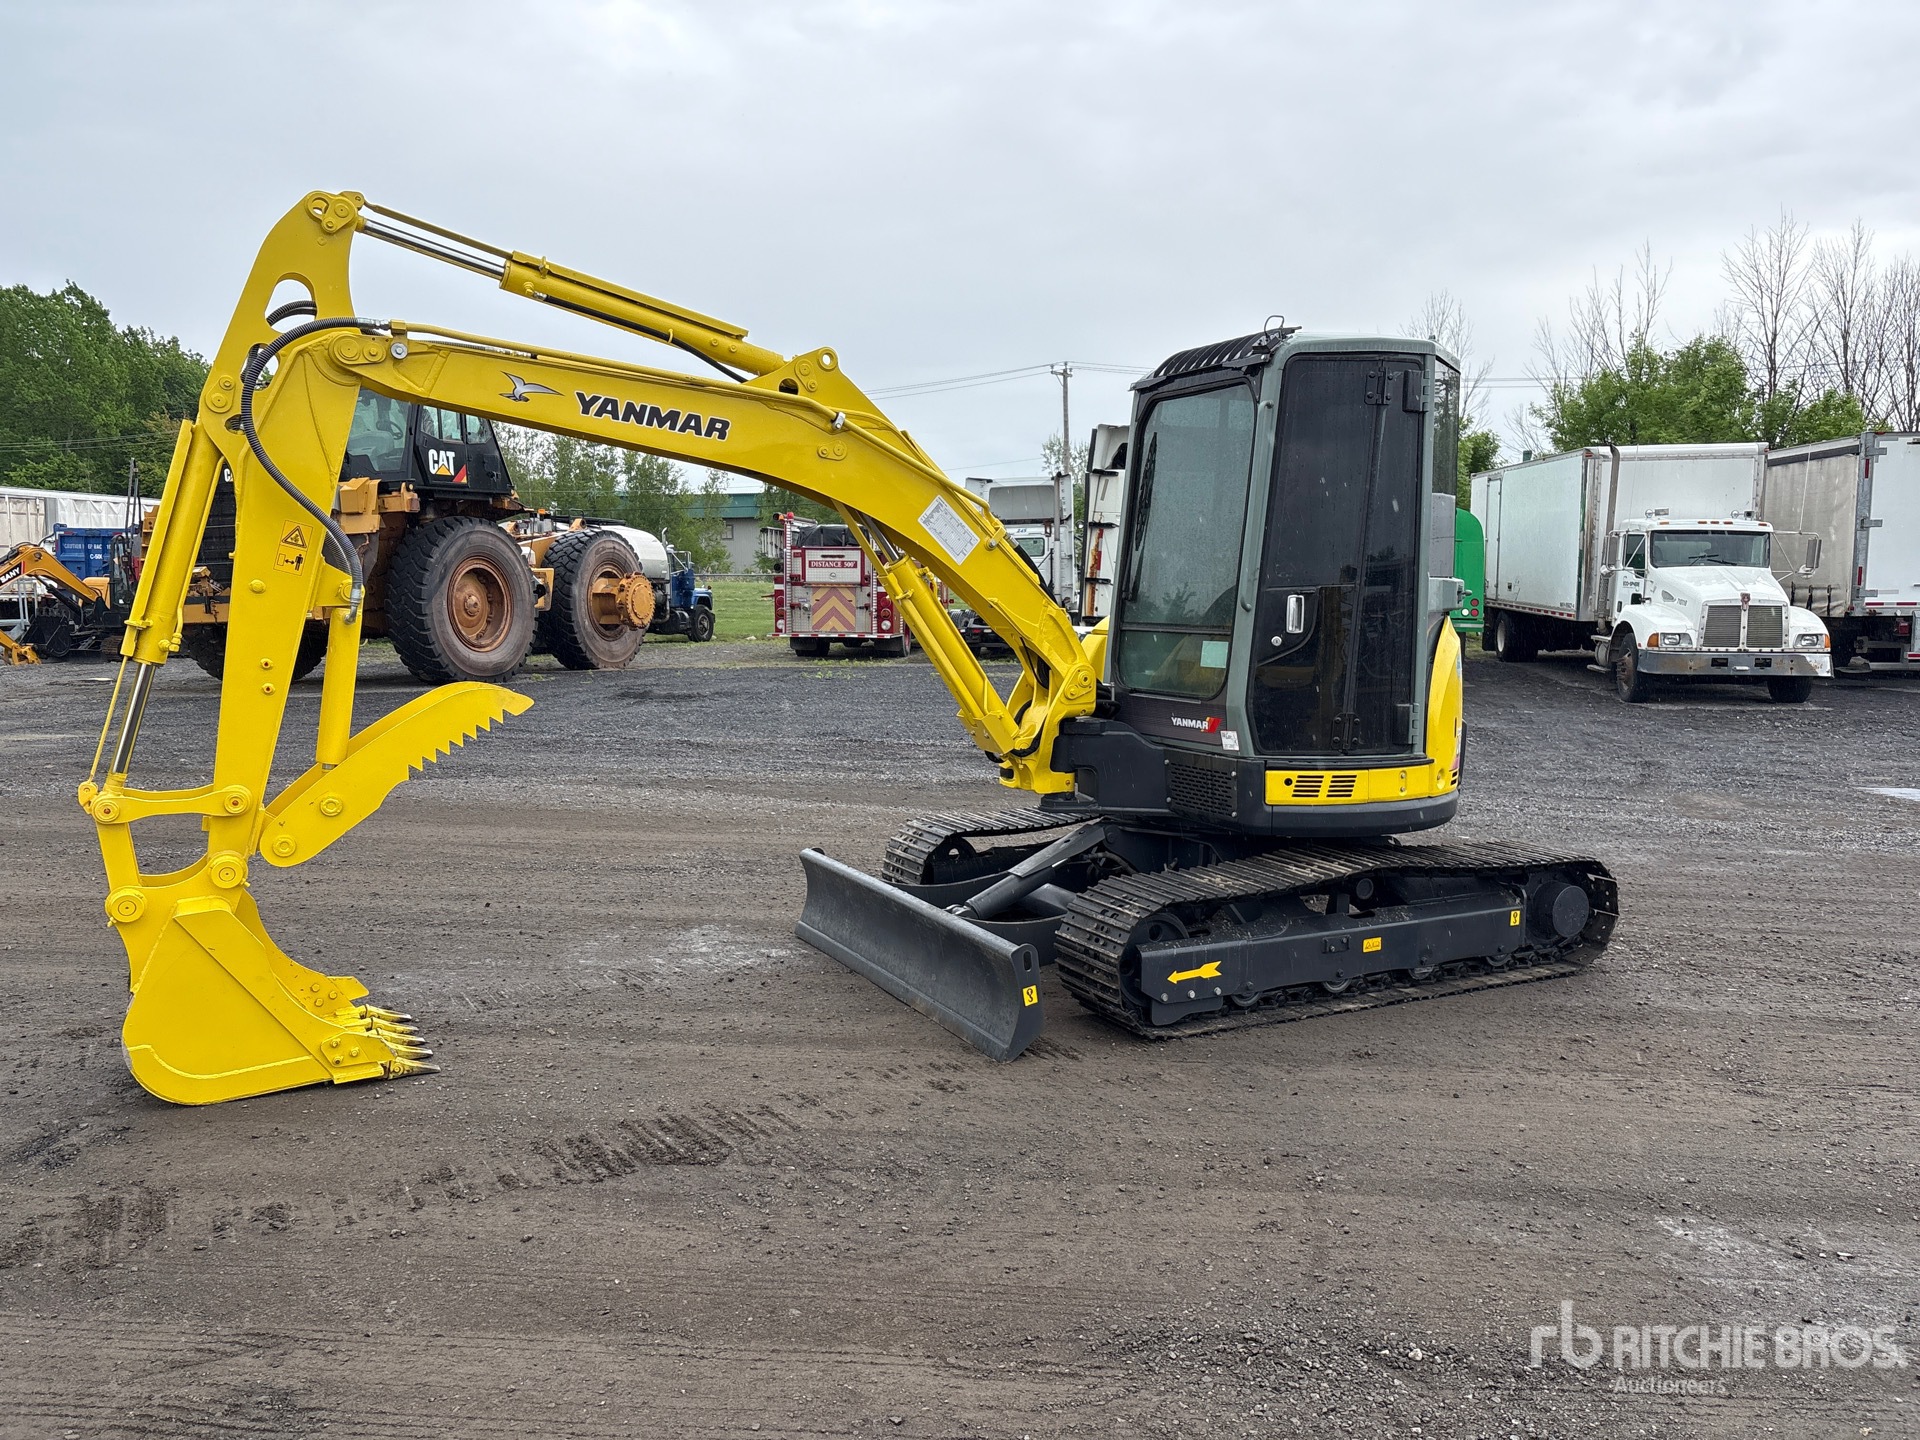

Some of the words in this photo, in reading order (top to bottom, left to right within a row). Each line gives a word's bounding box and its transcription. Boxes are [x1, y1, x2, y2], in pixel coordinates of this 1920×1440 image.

[575, 391, 731, 441] YANMAR
[428, 448, 456, 476] CAT
[0, 567, 20, 584] SANY
[1171, 716, 1209, 730] YANMAR
